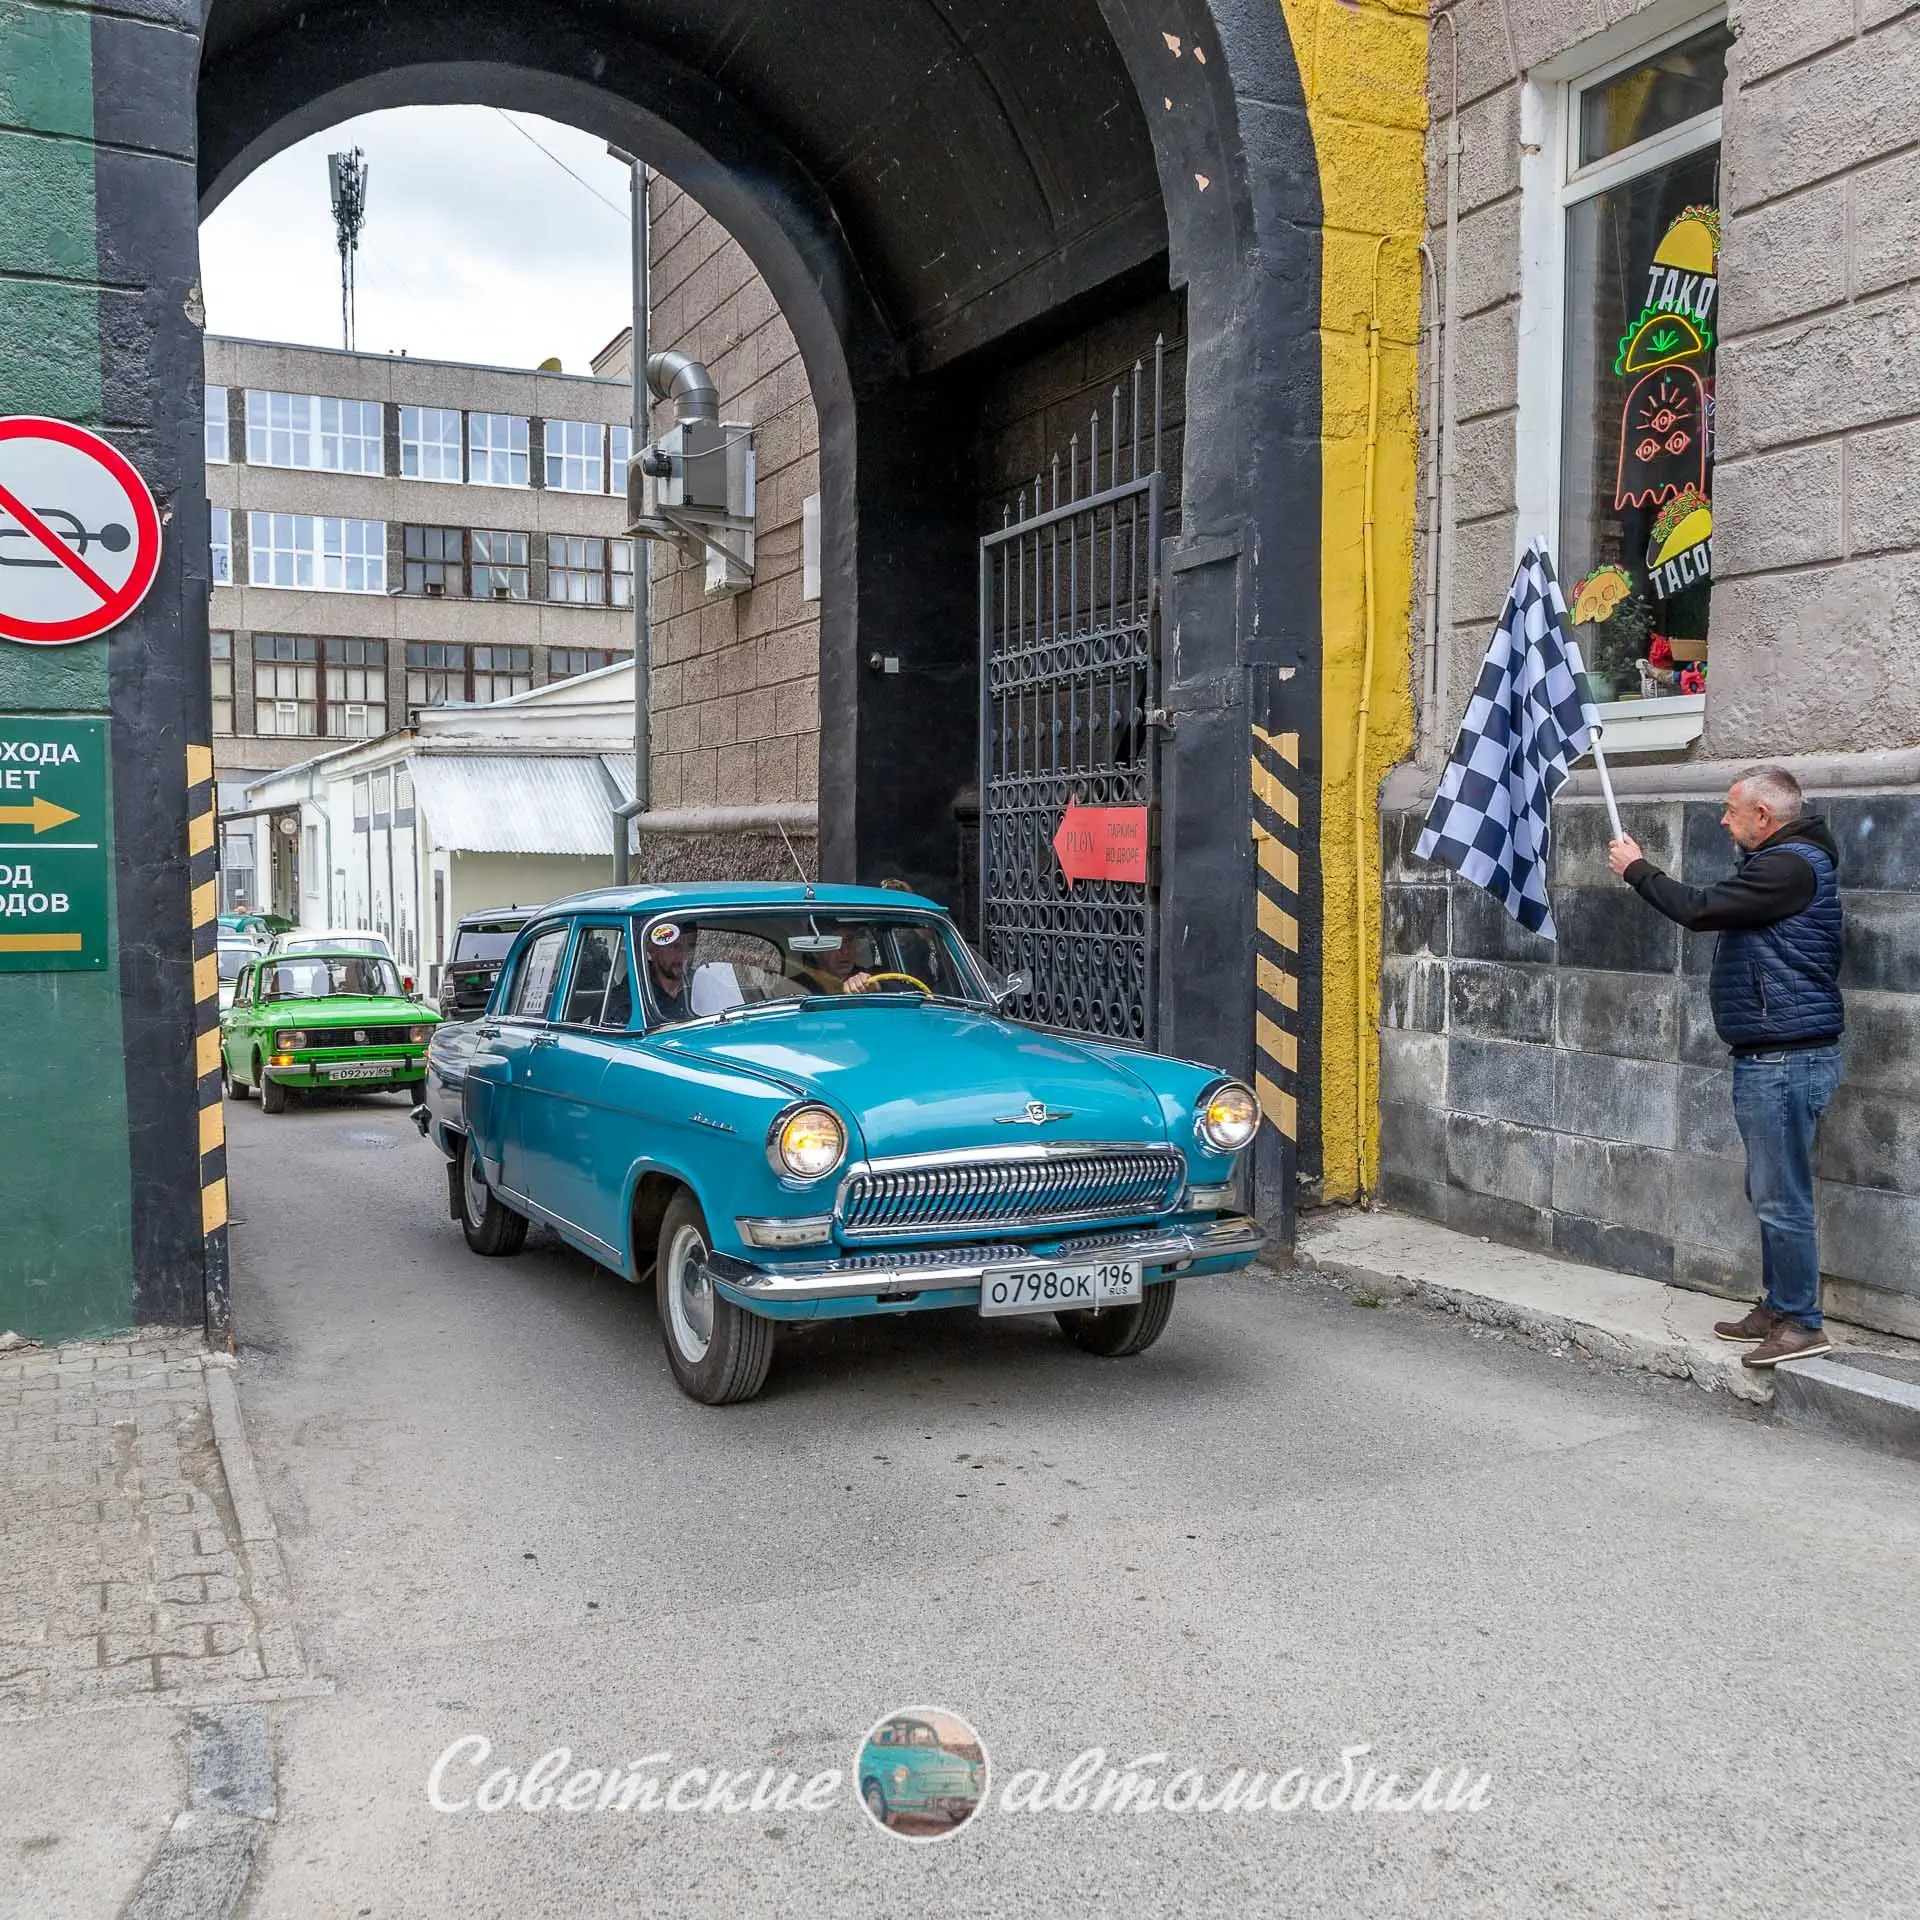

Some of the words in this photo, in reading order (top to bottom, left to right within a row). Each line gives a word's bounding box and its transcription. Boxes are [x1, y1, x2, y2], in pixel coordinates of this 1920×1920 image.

[1645, 265, 1717, 319] TAKO
[1648, 537, 1713, 600] TACO
[0, 742, 81, 766] ХОДА
[0, 769, 41, 790] ЕТ
[0, 892, 70, 917] ДОВ
[1097, 1264, 1133, 1288] 196
[1108, 1286, 1129, 1296] RUS
